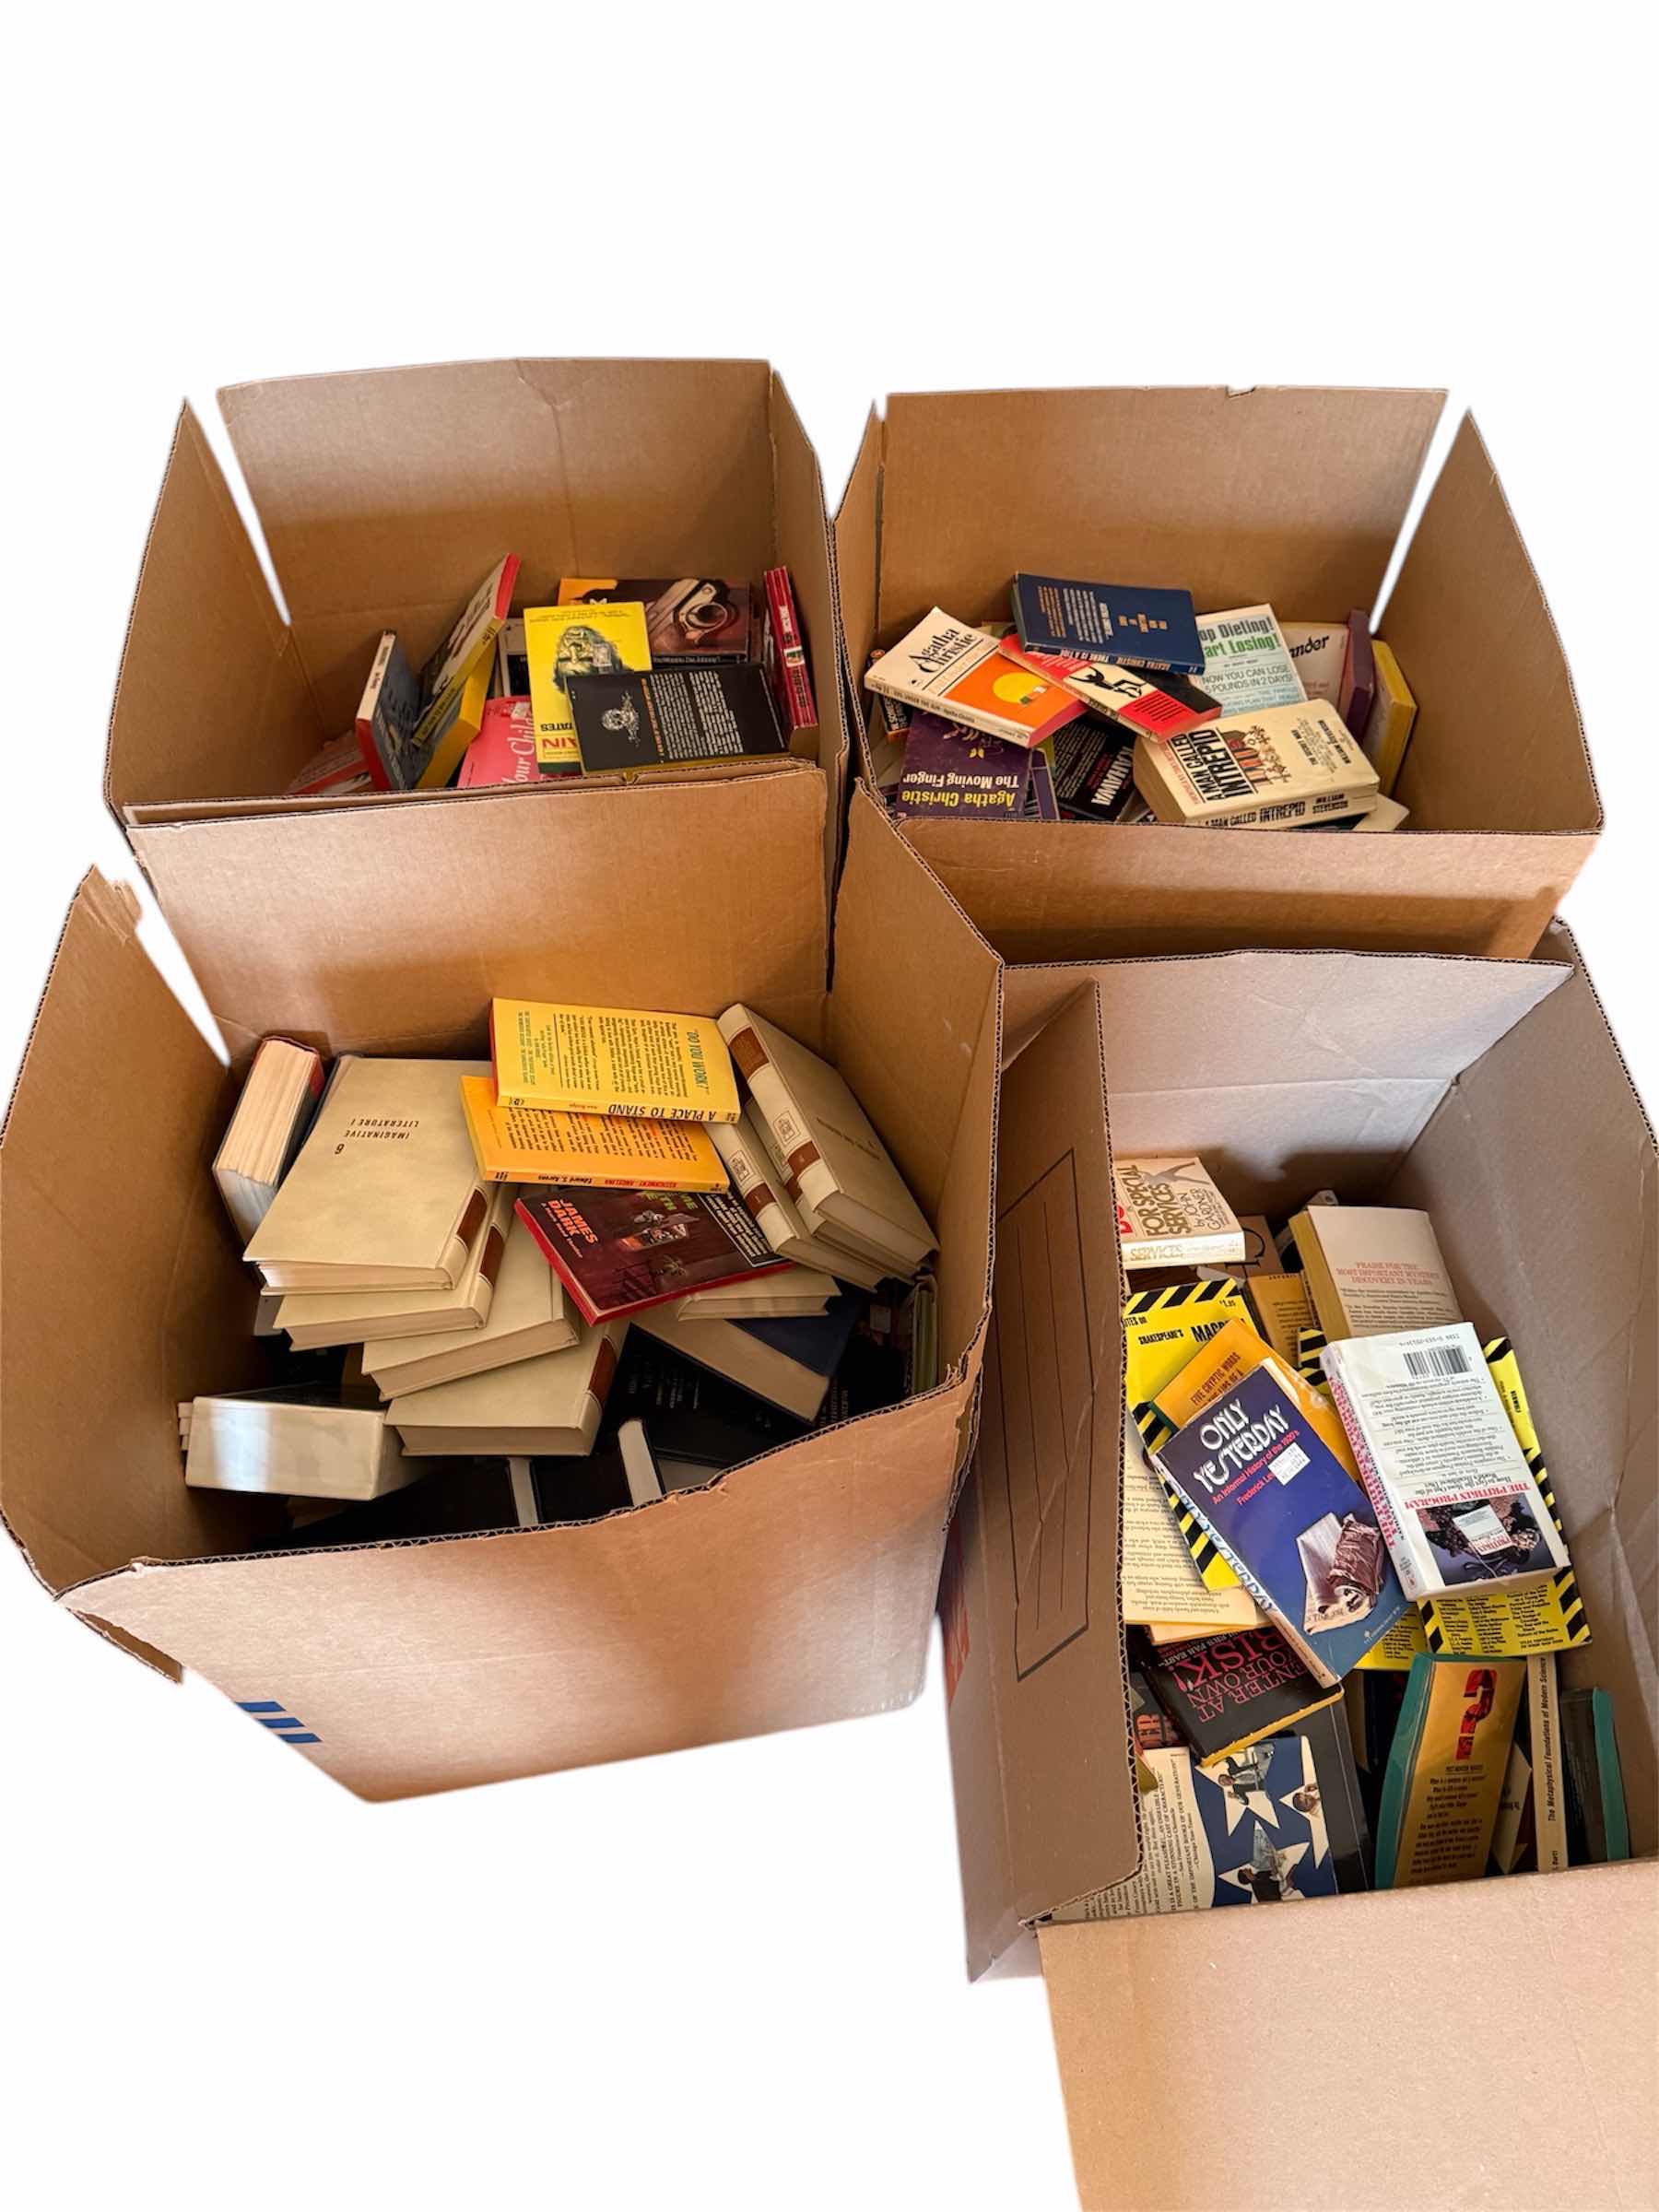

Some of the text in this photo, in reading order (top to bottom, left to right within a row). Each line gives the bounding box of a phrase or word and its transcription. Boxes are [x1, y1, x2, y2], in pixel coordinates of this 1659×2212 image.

[1199, 617, 1275, 642] op Dieting!
[909, 628, 959, 664] Agatha
[919, 633, 977, 673] Christie
[1205, 633, 1279, 658] art Losing!
[1212, 679, 1250, 693] POUNDS
[1260, 677, 1267, 686] 2
[1224, 670, 1244, 680] YOU
[1246, 667, 1266, 677] CAN
[1267, 665, 1289, 676] LOSE
[540, 723, 572, 732] TATES
[542, 737, 577, 748] AIN
[1171, 734, 1225, 802] A MAN CALLED
[1188, 728, 1254, 797] INTREPID
[903, 771, 1019, 790] The Moving Finger
[901, 789, 1016, 807] Agatha Christie
[1259, 801, 1306, 823] INTREPID
[359, 1119, 419, 1127] LITERATURE
[607, 1103, 716, 1121] A PLACE TO STAND
[335, 1144, 345, 1155] 6
[344, 1130, 410, 1139] IMAGINATIVE
[1117, 1165, 1150, 1206] SPECIAL
[547, 1200, 581, 1236] DARK
[1150, 1182, 1192, 1236] SERVICES
[1178, 1192, 1199, 1218] JOHN
[1190, 1188, 1221, 1231] GARDNER
[559, 1199, 598, 1244] JAMES
[1138, 1207, 1166, 1237] FOR
[1138, 1329, 1184, 1346] SHAKESPEARE'S
[1190, 1351, 1241, 1406] FIVE CRYPTIC WORDS
[1199, 1398, 1250, 1451] ONLY
[1193, 1404, 1289, 1494] YESTERDAY
[1212, 1493, 1223, 1505] An
[1222, 1475, 1245, 1498] Informal
[1244, 1457, 1268, 1481] History
[1271, 1442, 1282, 1455] the
[1236, 1482, 1265, 1506] Frederick
[1404, 1482, 1530, 1509] THE PRITIKIN PROGRAM
[1168, 1623, 1285, 1691] RISK!
[1187, 1669, 1241, 1710] OWN
[1196, 1658, 1307, 1724] ENTER AT
[1540, 1657, 1556, 1821] The Metaphysical Foundations of Modern Science
